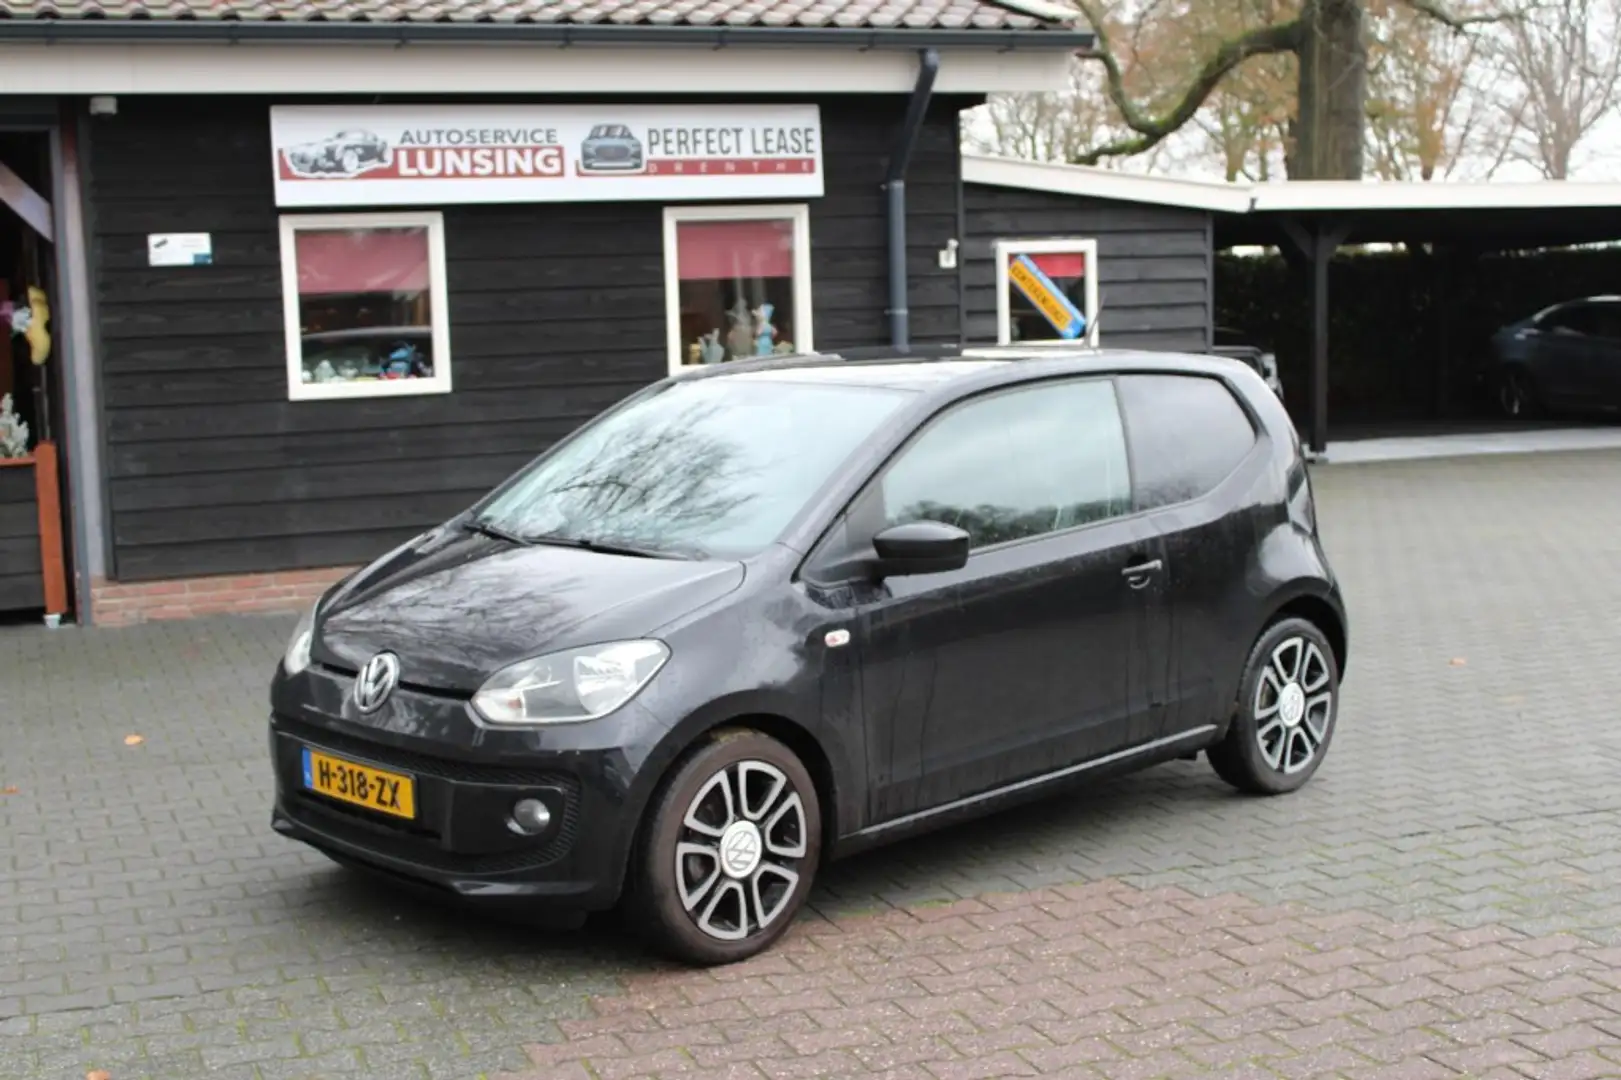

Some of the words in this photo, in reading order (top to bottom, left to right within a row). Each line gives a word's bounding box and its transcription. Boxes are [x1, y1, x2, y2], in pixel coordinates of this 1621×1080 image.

[400, 128, 558, 145] AUTOSERVICE
[647, 127, 744, 156] PERFECT
[750, 127, 815, 154] LEASE
[397, 147, 562, 177] LUNSING
[318, 759, 402, 811] H-318-ZX
